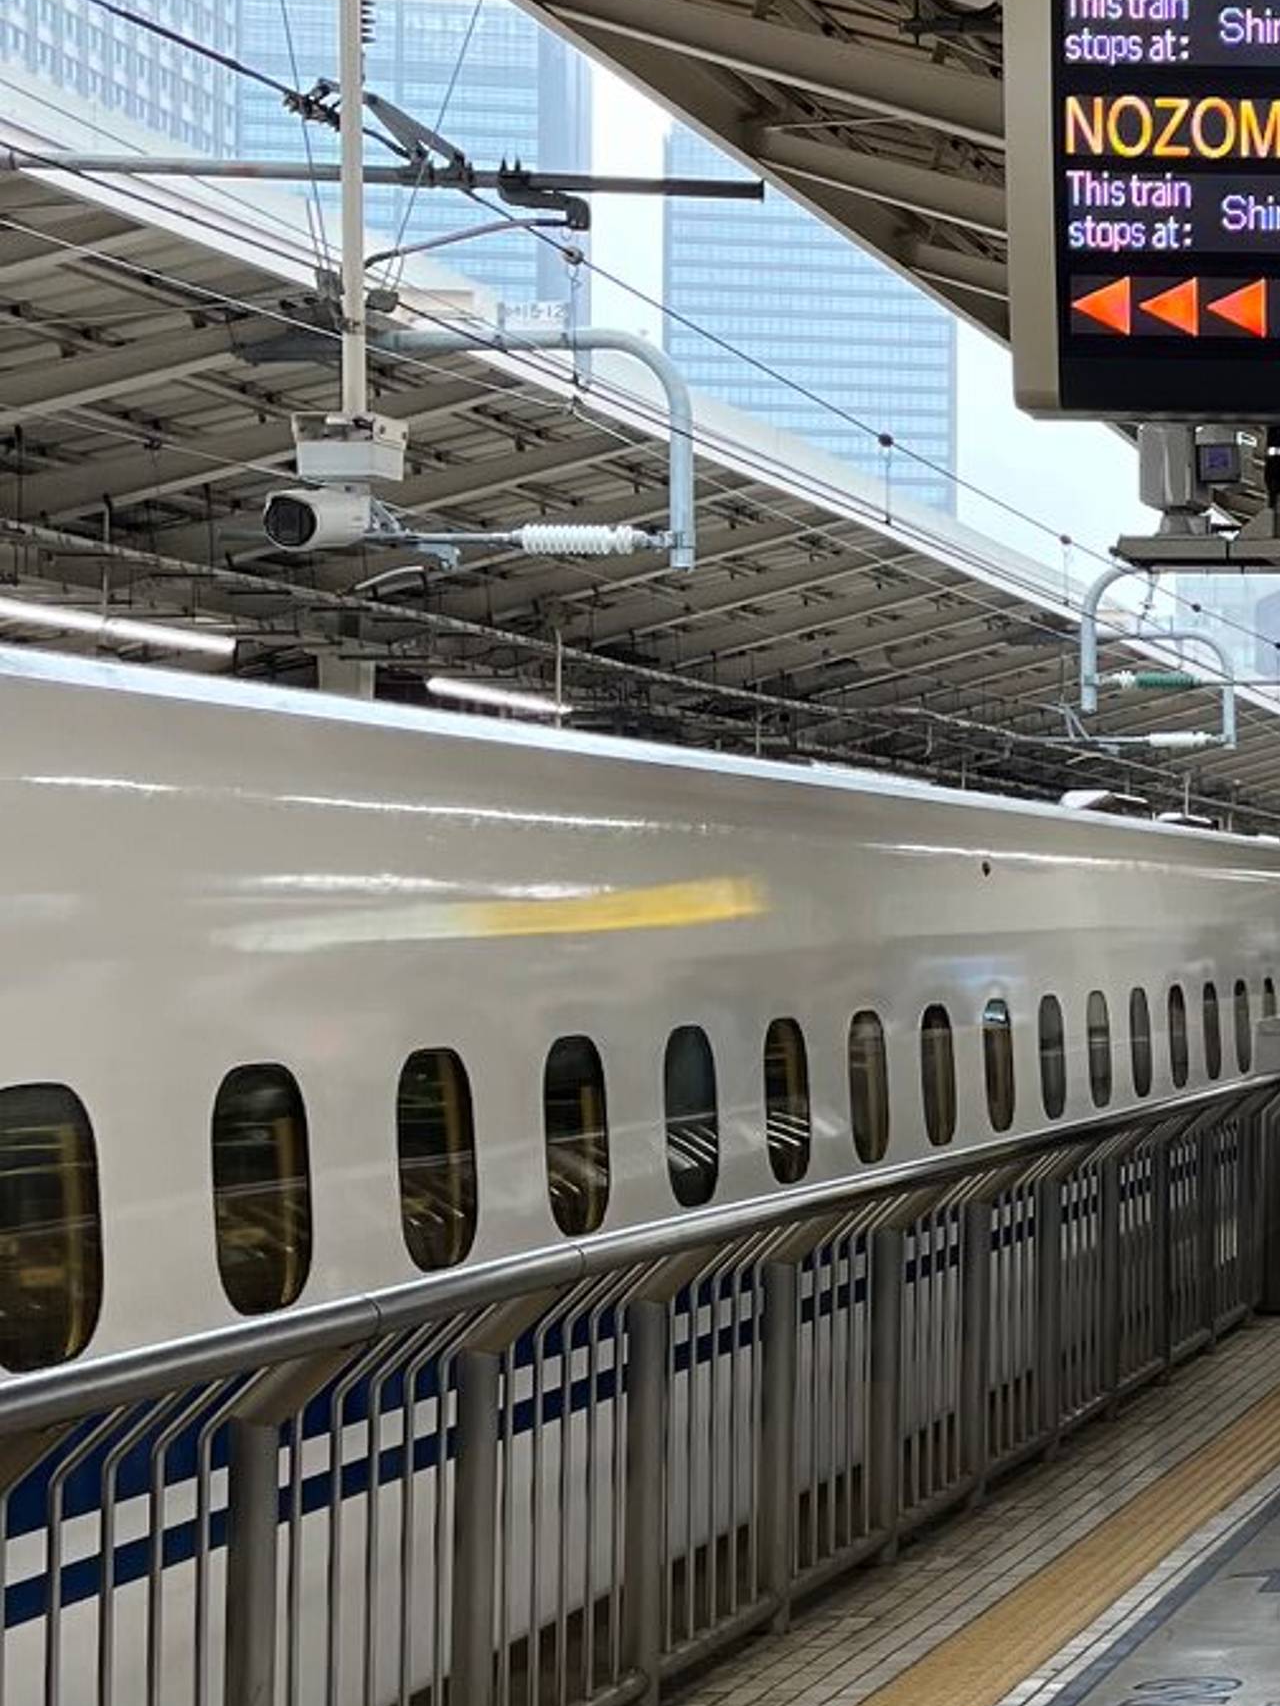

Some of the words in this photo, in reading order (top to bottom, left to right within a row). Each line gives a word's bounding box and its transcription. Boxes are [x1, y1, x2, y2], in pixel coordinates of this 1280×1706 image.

[1066, 28, 1143, 65] stops
[1067, 171, 1125, 206] This
[1130, 173, 1191, 207] train
[1069, 216, 1145, 251] stops
[1118, 1676, 1242, 1706] 2
